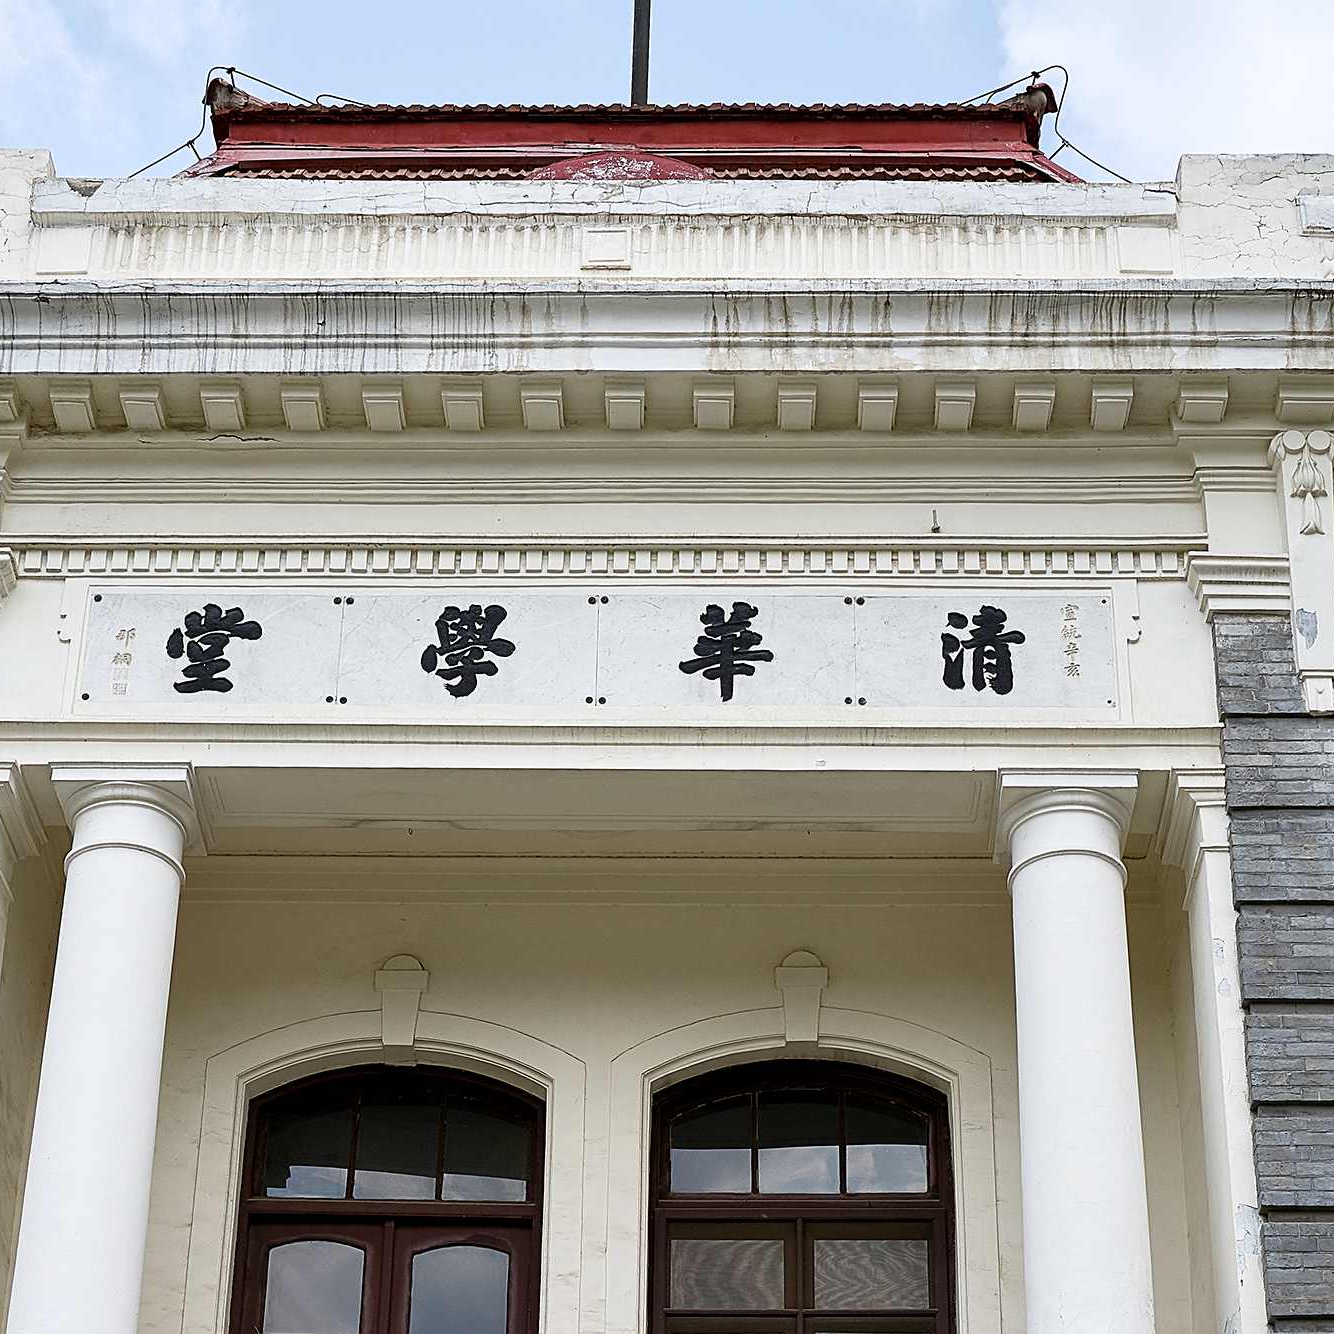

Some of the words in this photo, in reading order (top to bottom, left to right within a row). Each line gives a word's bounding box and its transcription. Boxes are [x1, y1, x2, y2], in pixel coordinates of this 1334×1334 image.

[165, 602, 1026, 701] 清華學堂
[1060, 603, 1083, 678] 宣統辛亥
